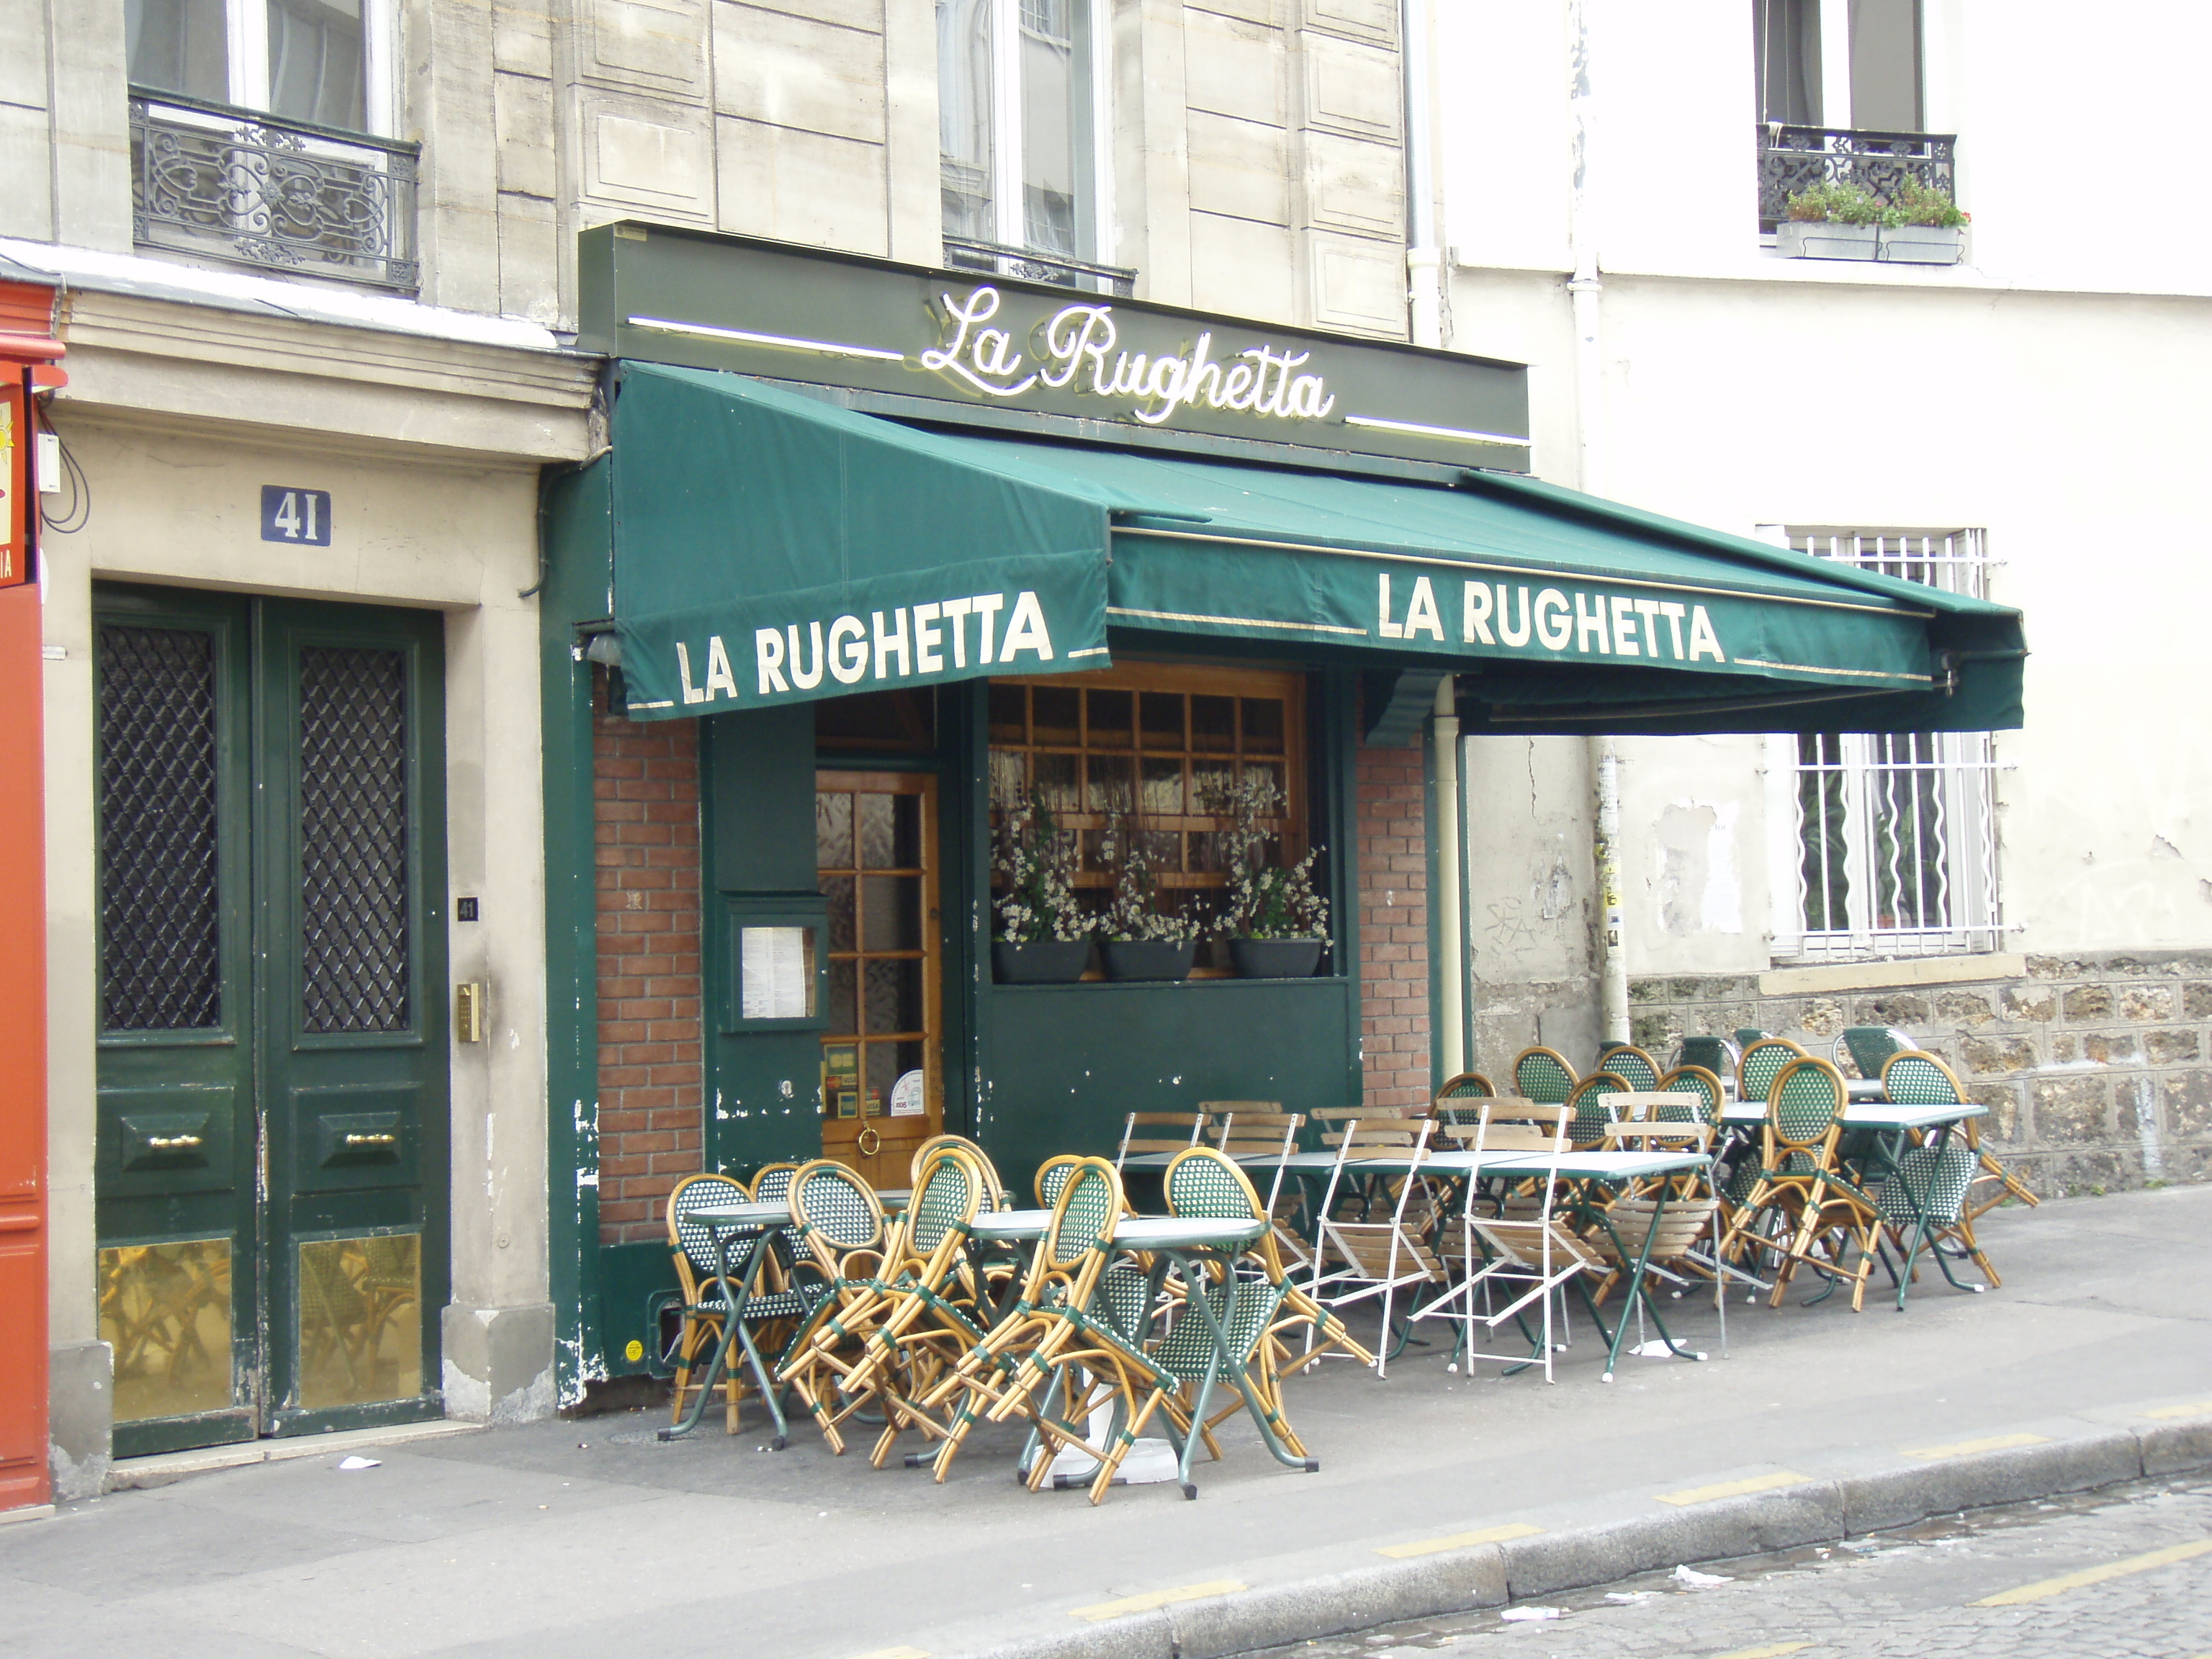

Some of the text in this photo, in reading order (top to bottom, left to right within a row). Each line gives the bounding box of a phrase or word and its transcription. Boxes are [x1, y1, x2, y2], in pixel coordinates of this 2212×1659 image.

[922, 286, 1335, 423] La Rughetta
[274, 492, 318, 540] 41
[676, 590, 1053, 705] LA RUGHETTA
[1378, 572, 1726, 663] LA RUGHETTA
[460, 901, 474, 918] 41
